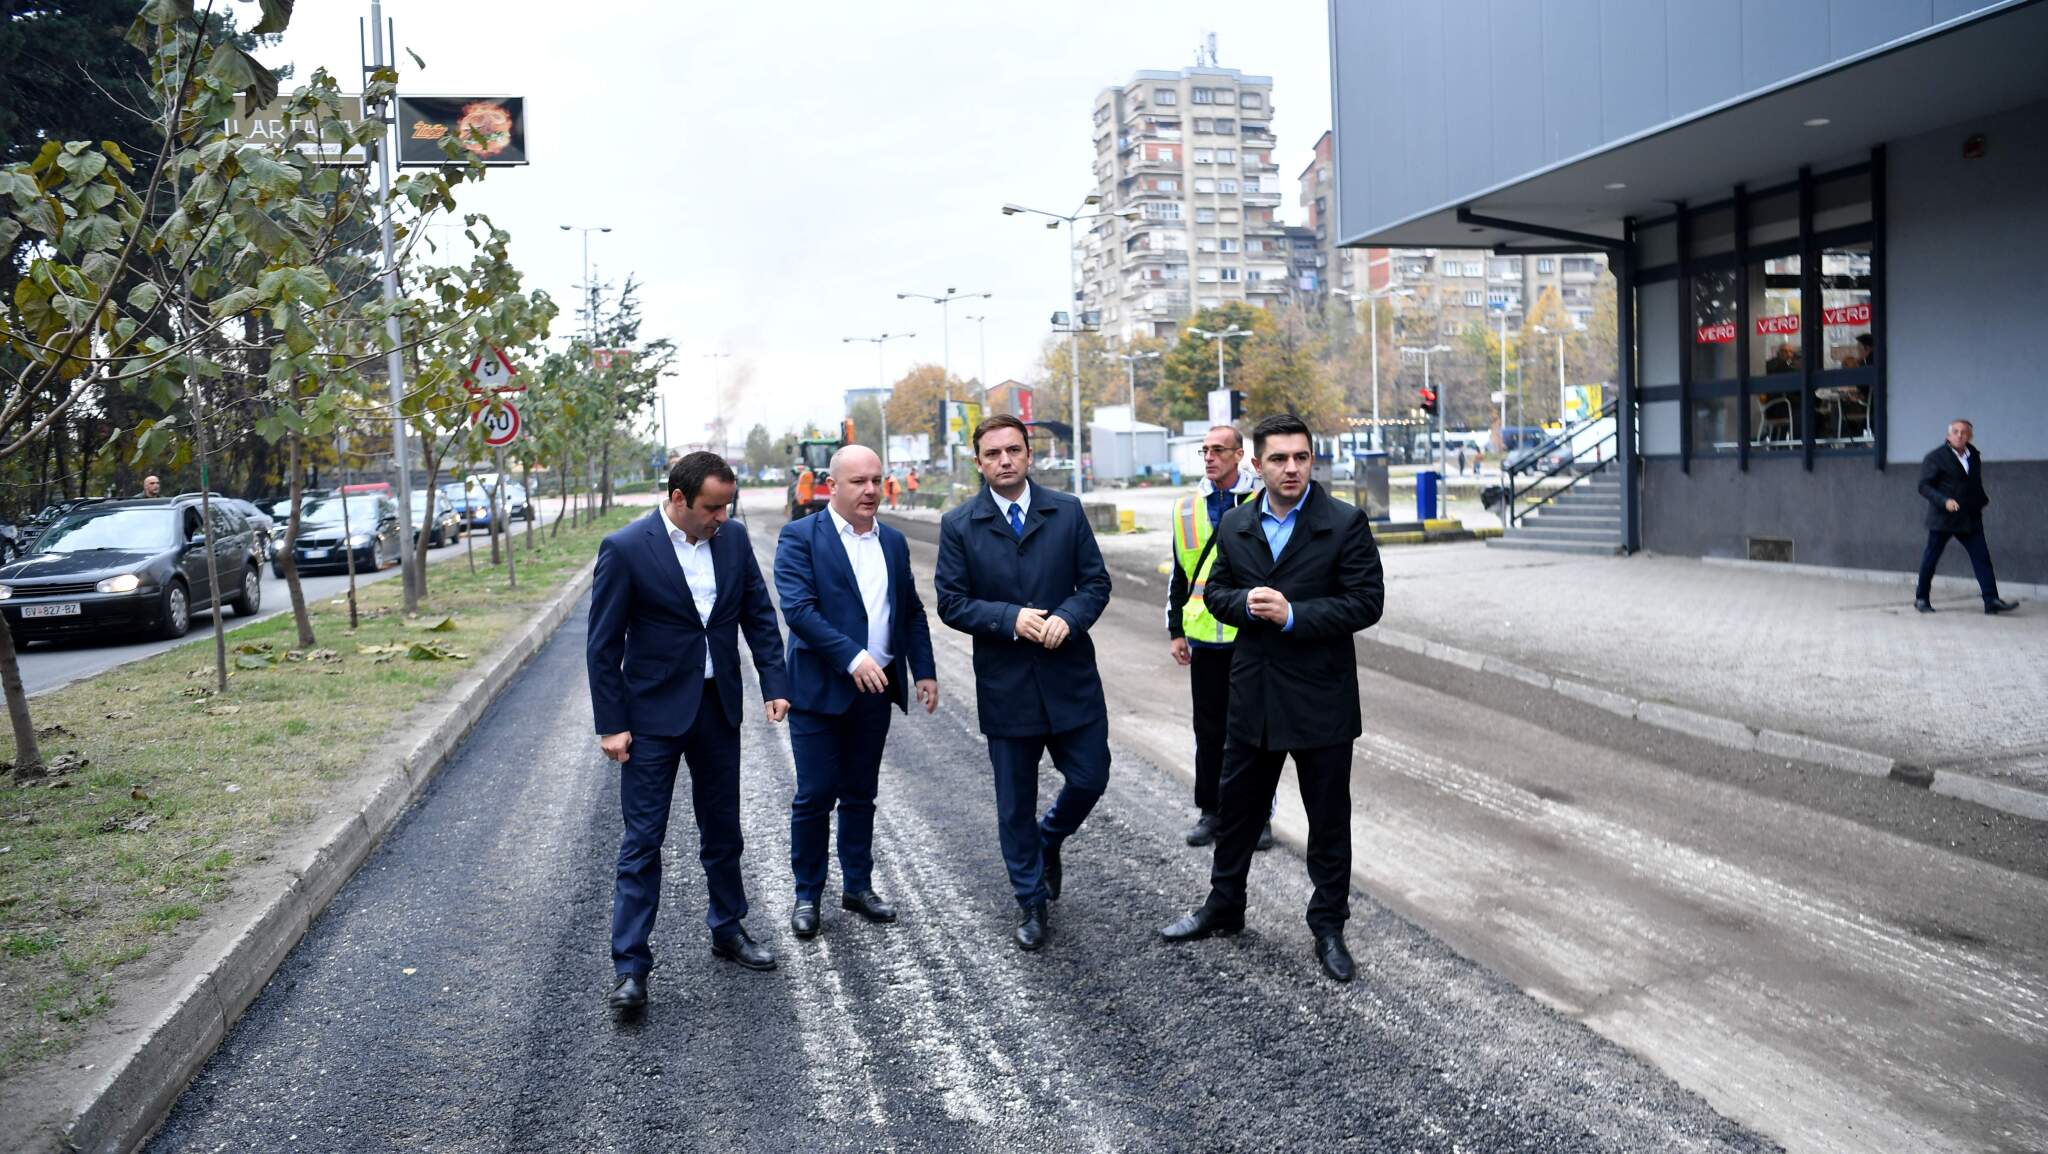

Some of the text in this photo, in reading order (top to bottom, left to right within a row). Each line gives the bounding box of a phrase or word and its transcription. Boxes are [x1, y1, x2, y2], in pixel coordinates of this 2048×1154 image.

[1825, 306, 1870, 324] VERO
[1698, 325, 1736, 341] VERO
[1758, 316, 1799, 333] VERO
